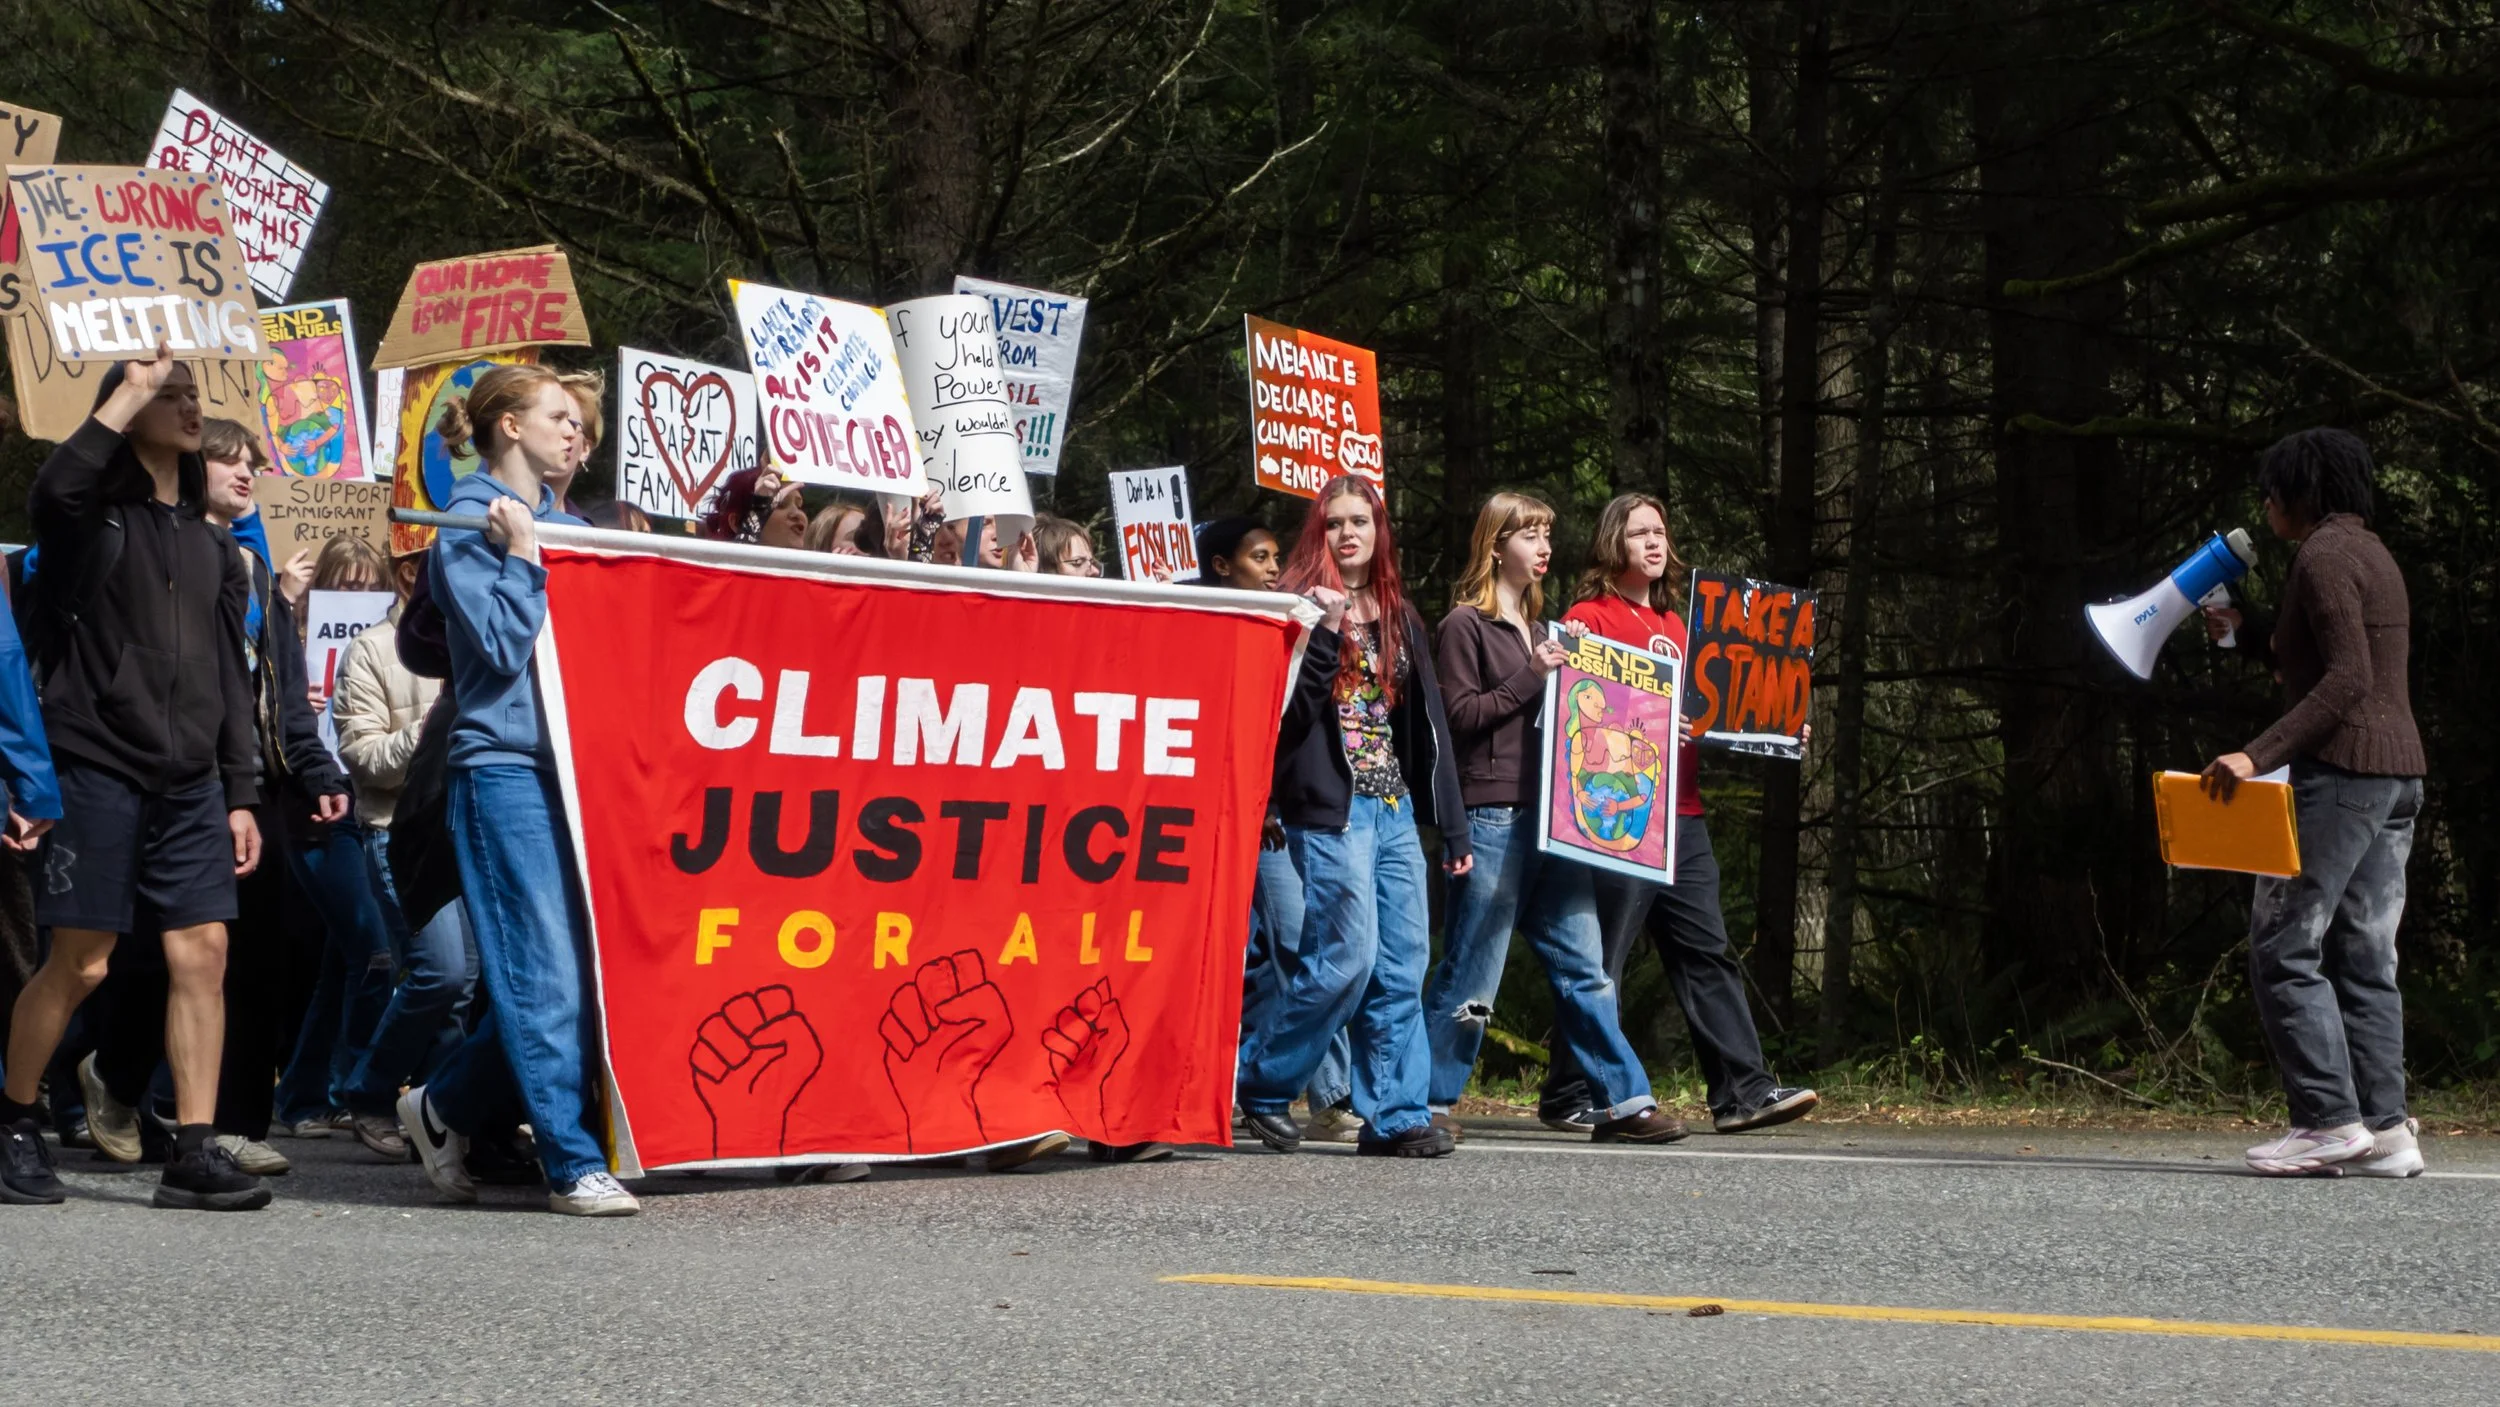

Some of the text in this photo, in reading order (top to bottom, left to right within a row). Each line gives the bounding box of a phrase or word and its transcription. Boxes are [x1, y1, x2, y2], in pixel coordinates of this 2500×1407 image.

[9, 170, 225, 238] THE WRONG
[205, 156, 313, 215] ANOTHER
[240, 237, 279, 265] LL
[262, 212, 300, 249] HIS
[36, 232, 224, 297] ICE IS
[416, 255, 553, 297] OUR HOME
[50, 294, 258, 353] MELTING
[260, 308, 324, 329] END
[296, 320, 343, 339] FUELS
[433, 296, 464, 325] ON
[461, 289, 567, 349] FIRE
[984, 293, 1068, 336] VEST
[797, 351, 820, 385] IS
[817, 316, 838, 354] IT
[962, 343, 994, 368] held
[635, 361, 722, 421] STOP
[934, 373, 1002, 403] Power
[1007, 382, 1040, 406] SIL
[1256, 380, 1357, 431] DECLARE A
[1257, 419, 1335, 460] CLIMATE
[1342, 440, 1381, 469] NOW
[269, 504, 375, 520] IMMIGRANT
[290, 480, 390, 504] SUPPORT
[294, 523, 370, 541] RIGHTS
[1168, 522, 1197, 571] FOOL
[1698, 580, 1814, 650] TAKE A
[2134, 604, 2158, 625] PYLE
[1567, 651, 1673, 698] OSSIL FUELS
[1579, 637, 1656, 676] END
[1690, 642, 1811, 738] STAND
[684, 656, 1200, 776] CLIMATE
[670, 787, 1195, 885] JUSTICE
[695, 907, 1154, 969] FOR ALL
